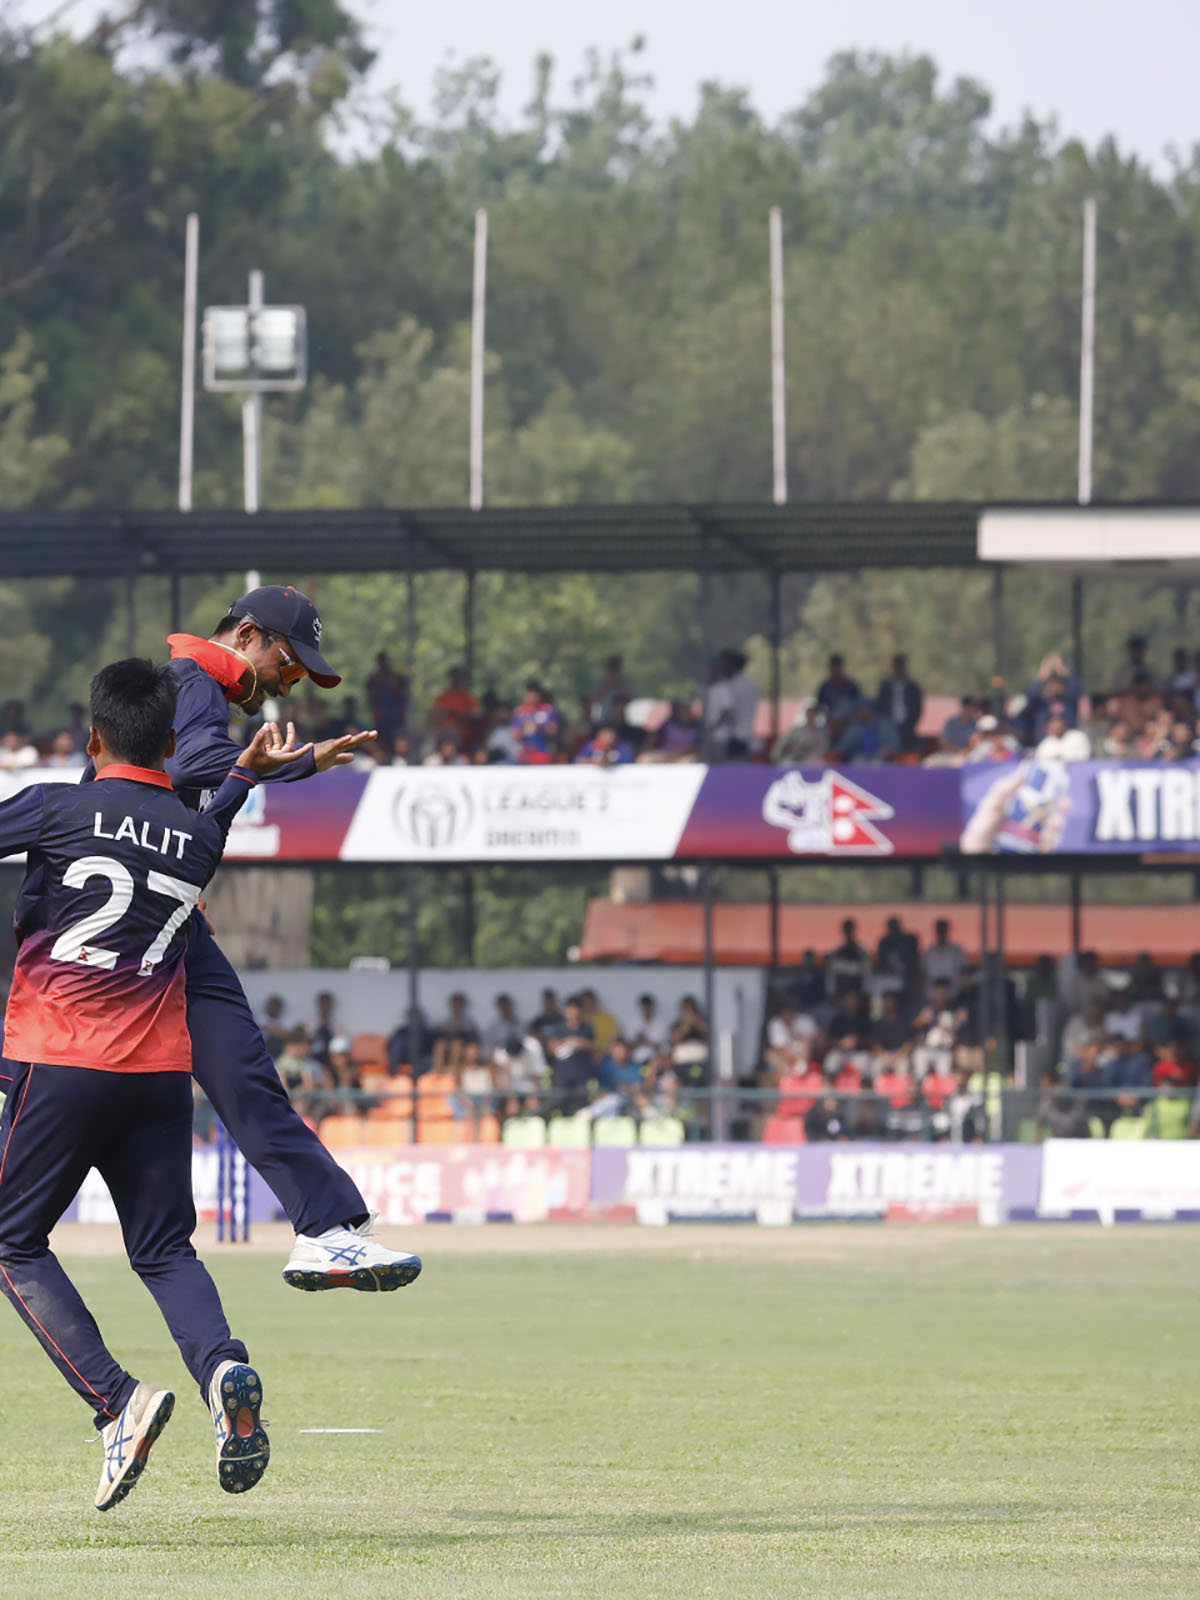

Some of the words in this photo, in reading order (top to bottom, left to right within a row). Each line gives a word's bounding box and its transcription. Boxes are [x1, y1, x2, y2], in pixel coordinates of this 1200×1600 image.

[1095, 768, 1200, 840] XTR
[93, 812, 193, 859] LALIT
[50, 856, 202, 976] 27
[625, 1151, 798, 1198] XTREME
[828, 1152, 1004, 1199] XTREME
